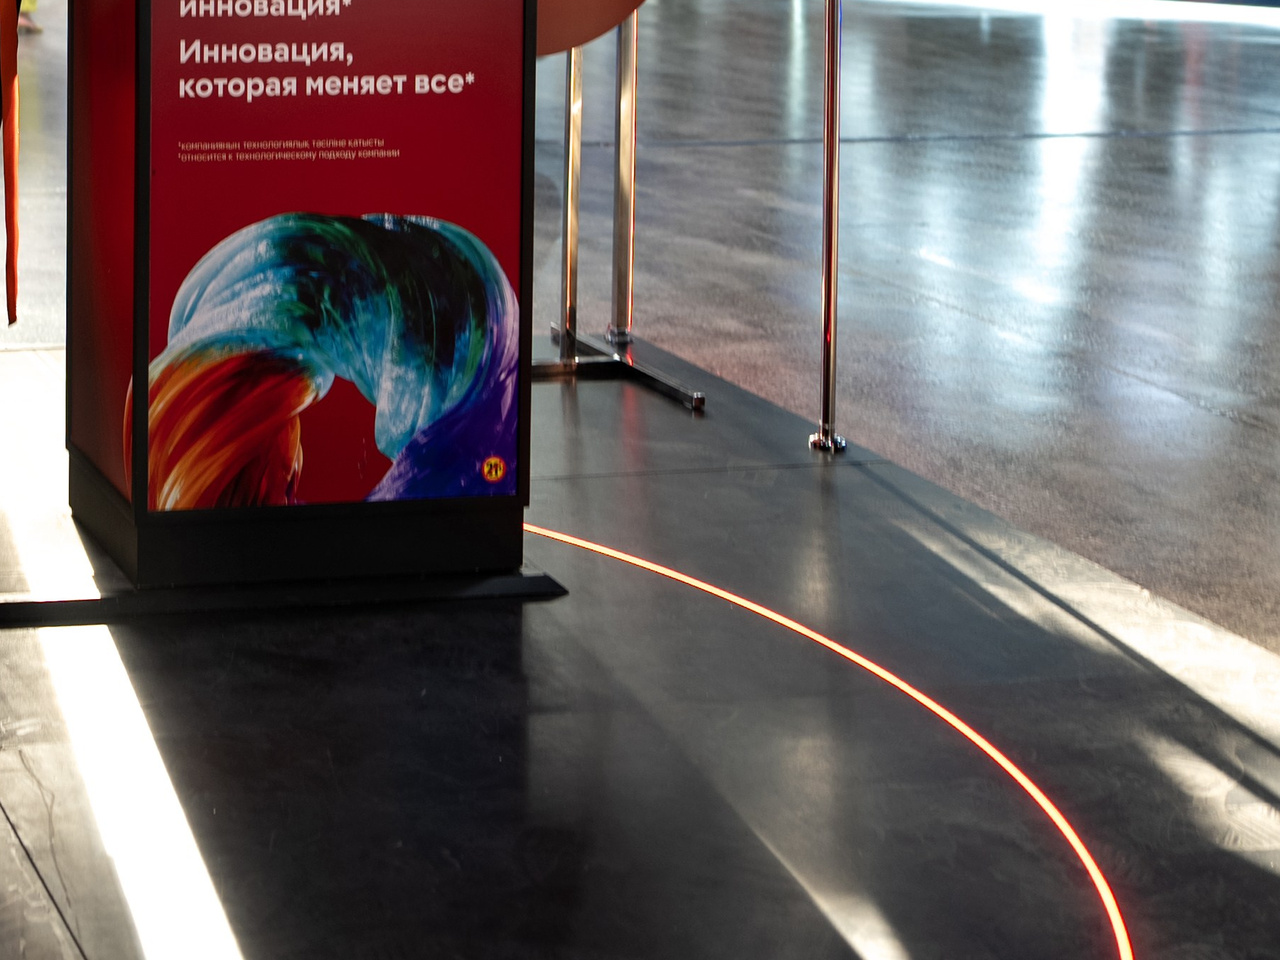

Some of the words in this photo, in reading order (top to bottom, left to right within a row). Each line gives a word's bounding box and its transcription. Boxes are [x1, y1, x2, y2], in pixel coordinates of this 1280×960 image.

[179, 39, 354, 66] Инновация,
[179, 76, 297, 103] которая
[306, 75, 407, 97] меняет
[319, 149, 356, 161] подходу
